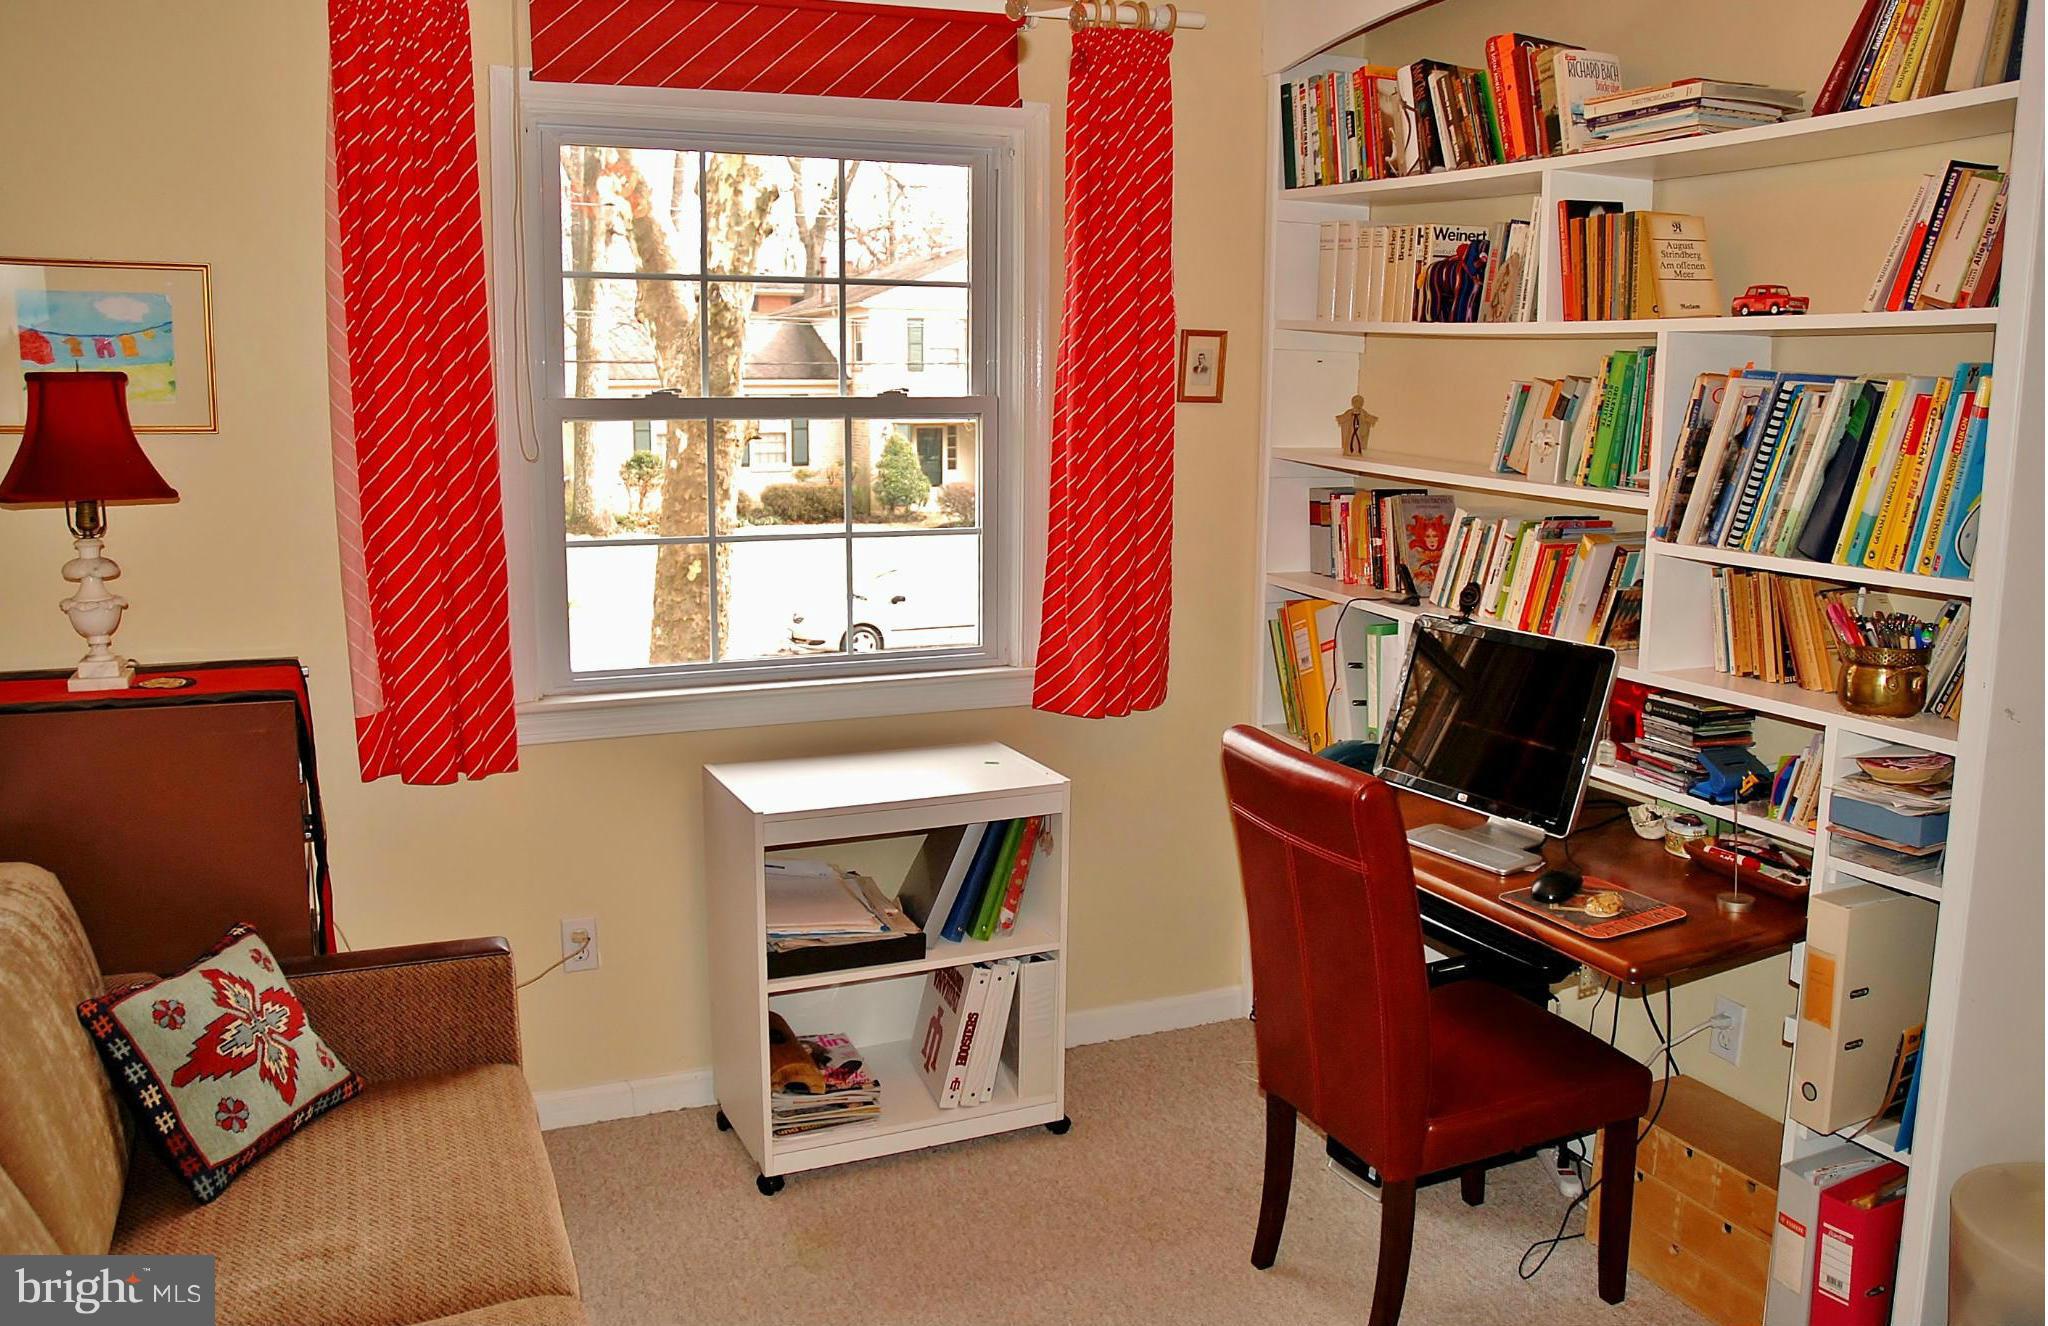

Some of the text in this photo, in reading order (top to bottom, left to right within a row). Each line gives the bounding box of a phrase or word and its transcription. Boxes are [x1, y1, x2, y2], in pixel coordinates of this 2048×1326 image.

[1567, 61, 1600, 79] RICHARD
[1601, 63, 1620, 82] BACH
[1983, 226, 1992, 239] im
[1988, 201, 2002, 225] Griff
[1433, 227, 1488, 242] Weinert
[1398, 228, 1406, 260] Brecht
[1666, 241, 1694, 251] August
[1660, 250, 1702, 261] Strindberg
[1660, 261, 1706, 270] Am offenen
[1673, 270, 1695, 278] Meer
[1927, 518, 1941, 550] GROSSES
[1936, 482, 1951, 516] FARBIGES
[1872, 513, 1887, 544] GROSSES
